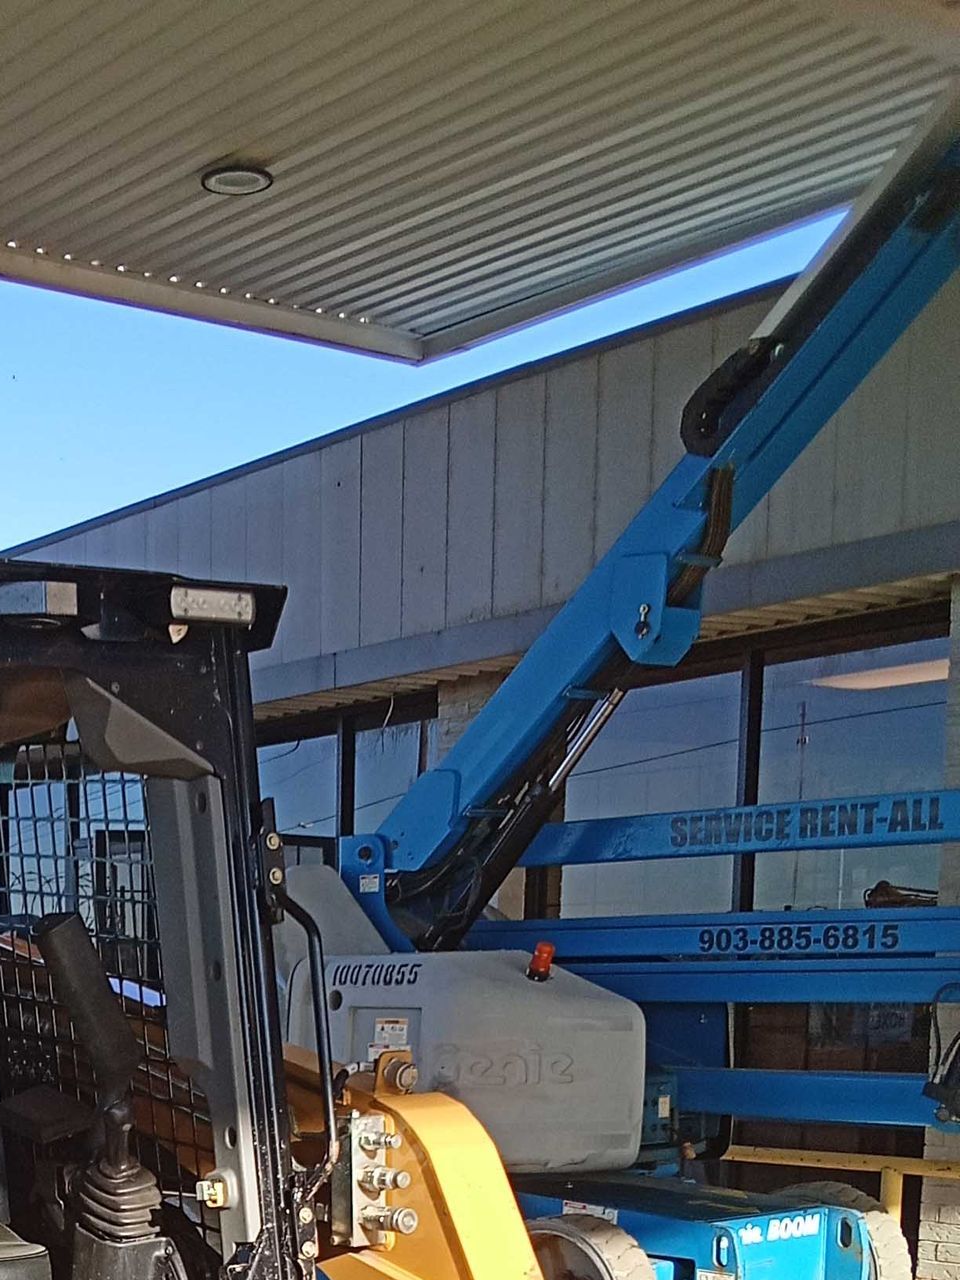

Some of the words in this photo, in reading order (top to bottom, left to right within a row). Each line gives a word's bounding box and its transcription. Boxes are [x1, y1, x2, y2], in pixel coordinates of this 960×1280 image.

[670, 808, 791, 847] SERVICE
[799, 797, 944, 838] RENT-ALL
[699, 924, 899, 951] 903-885-6815
[767, 1213, 820, 1242] BOOM
